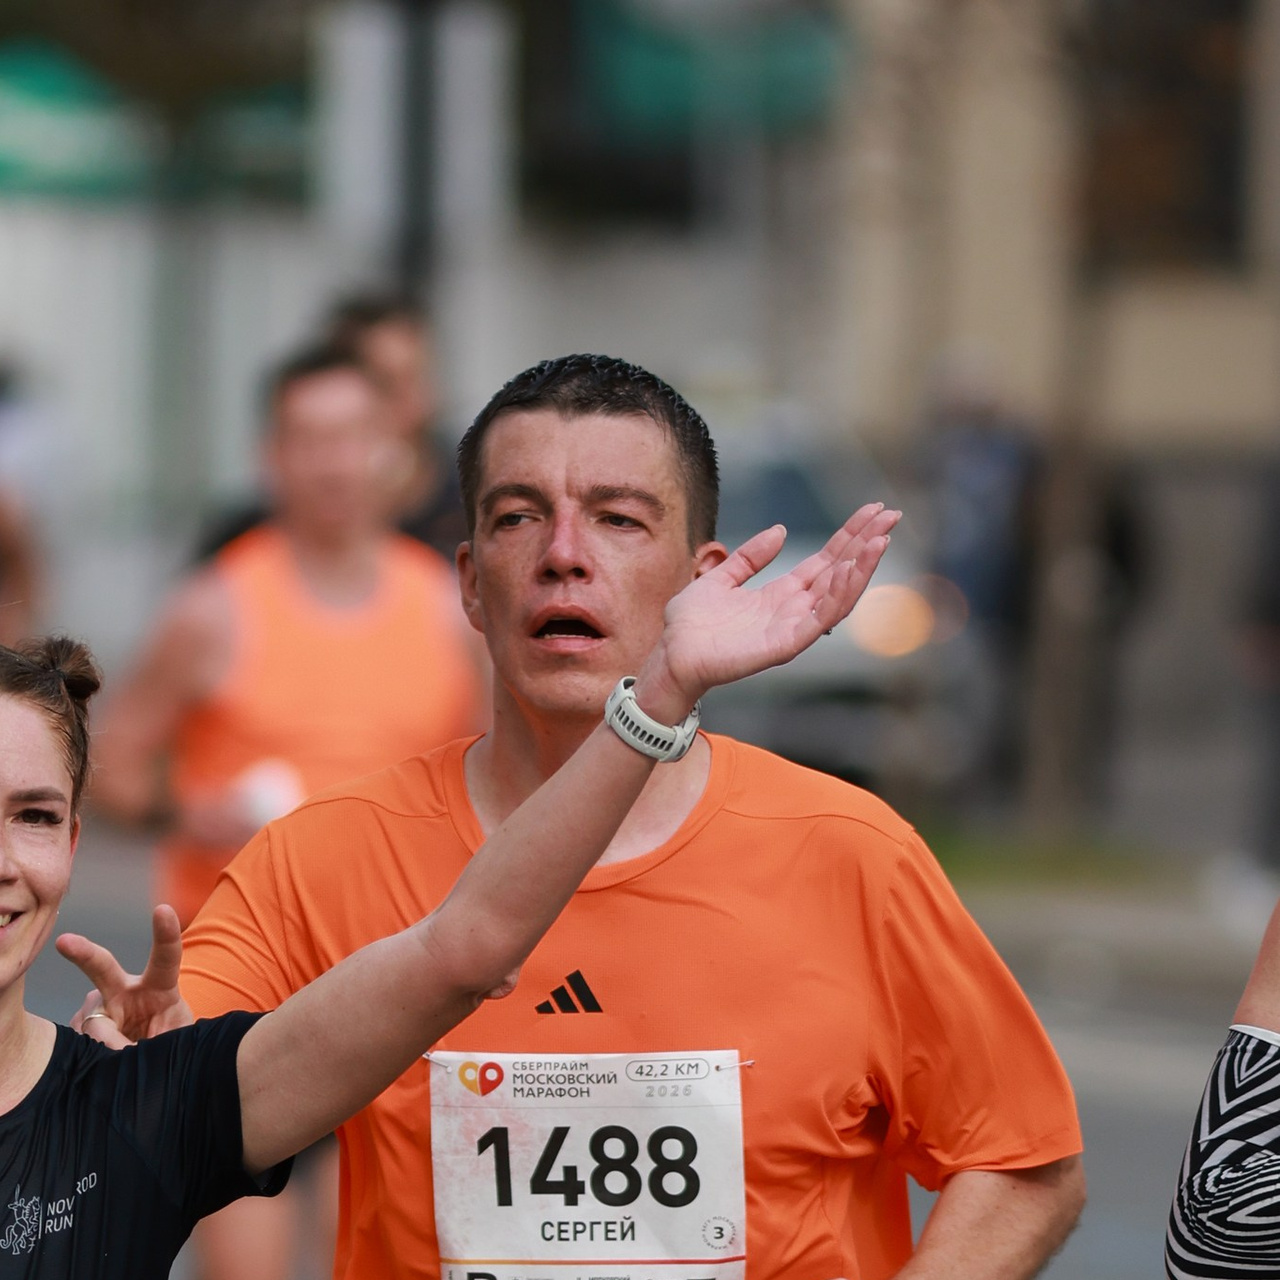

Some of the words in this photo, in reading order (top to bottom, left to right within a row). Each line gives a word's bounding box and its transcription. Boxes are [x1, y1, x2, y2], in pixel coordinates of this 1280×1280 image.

[512, 1060, 589, 1071] СБЕРПРАЙМ
[635, 1064, 669, 1078] 42,2
[513, 1071, 618, 1085] МОСКОВСКИЙ
[513, 1086, 591, 1098] МАРАФОН
[645, 1085, 693, 1098] 2026
[476, 1125, 701, 1208] 1488
[44, 1213, 74, 1235] RUN
[540, 1215, 636, 1242] СЕРГЕЙ
[713, 1226, 725, 1240] 3
